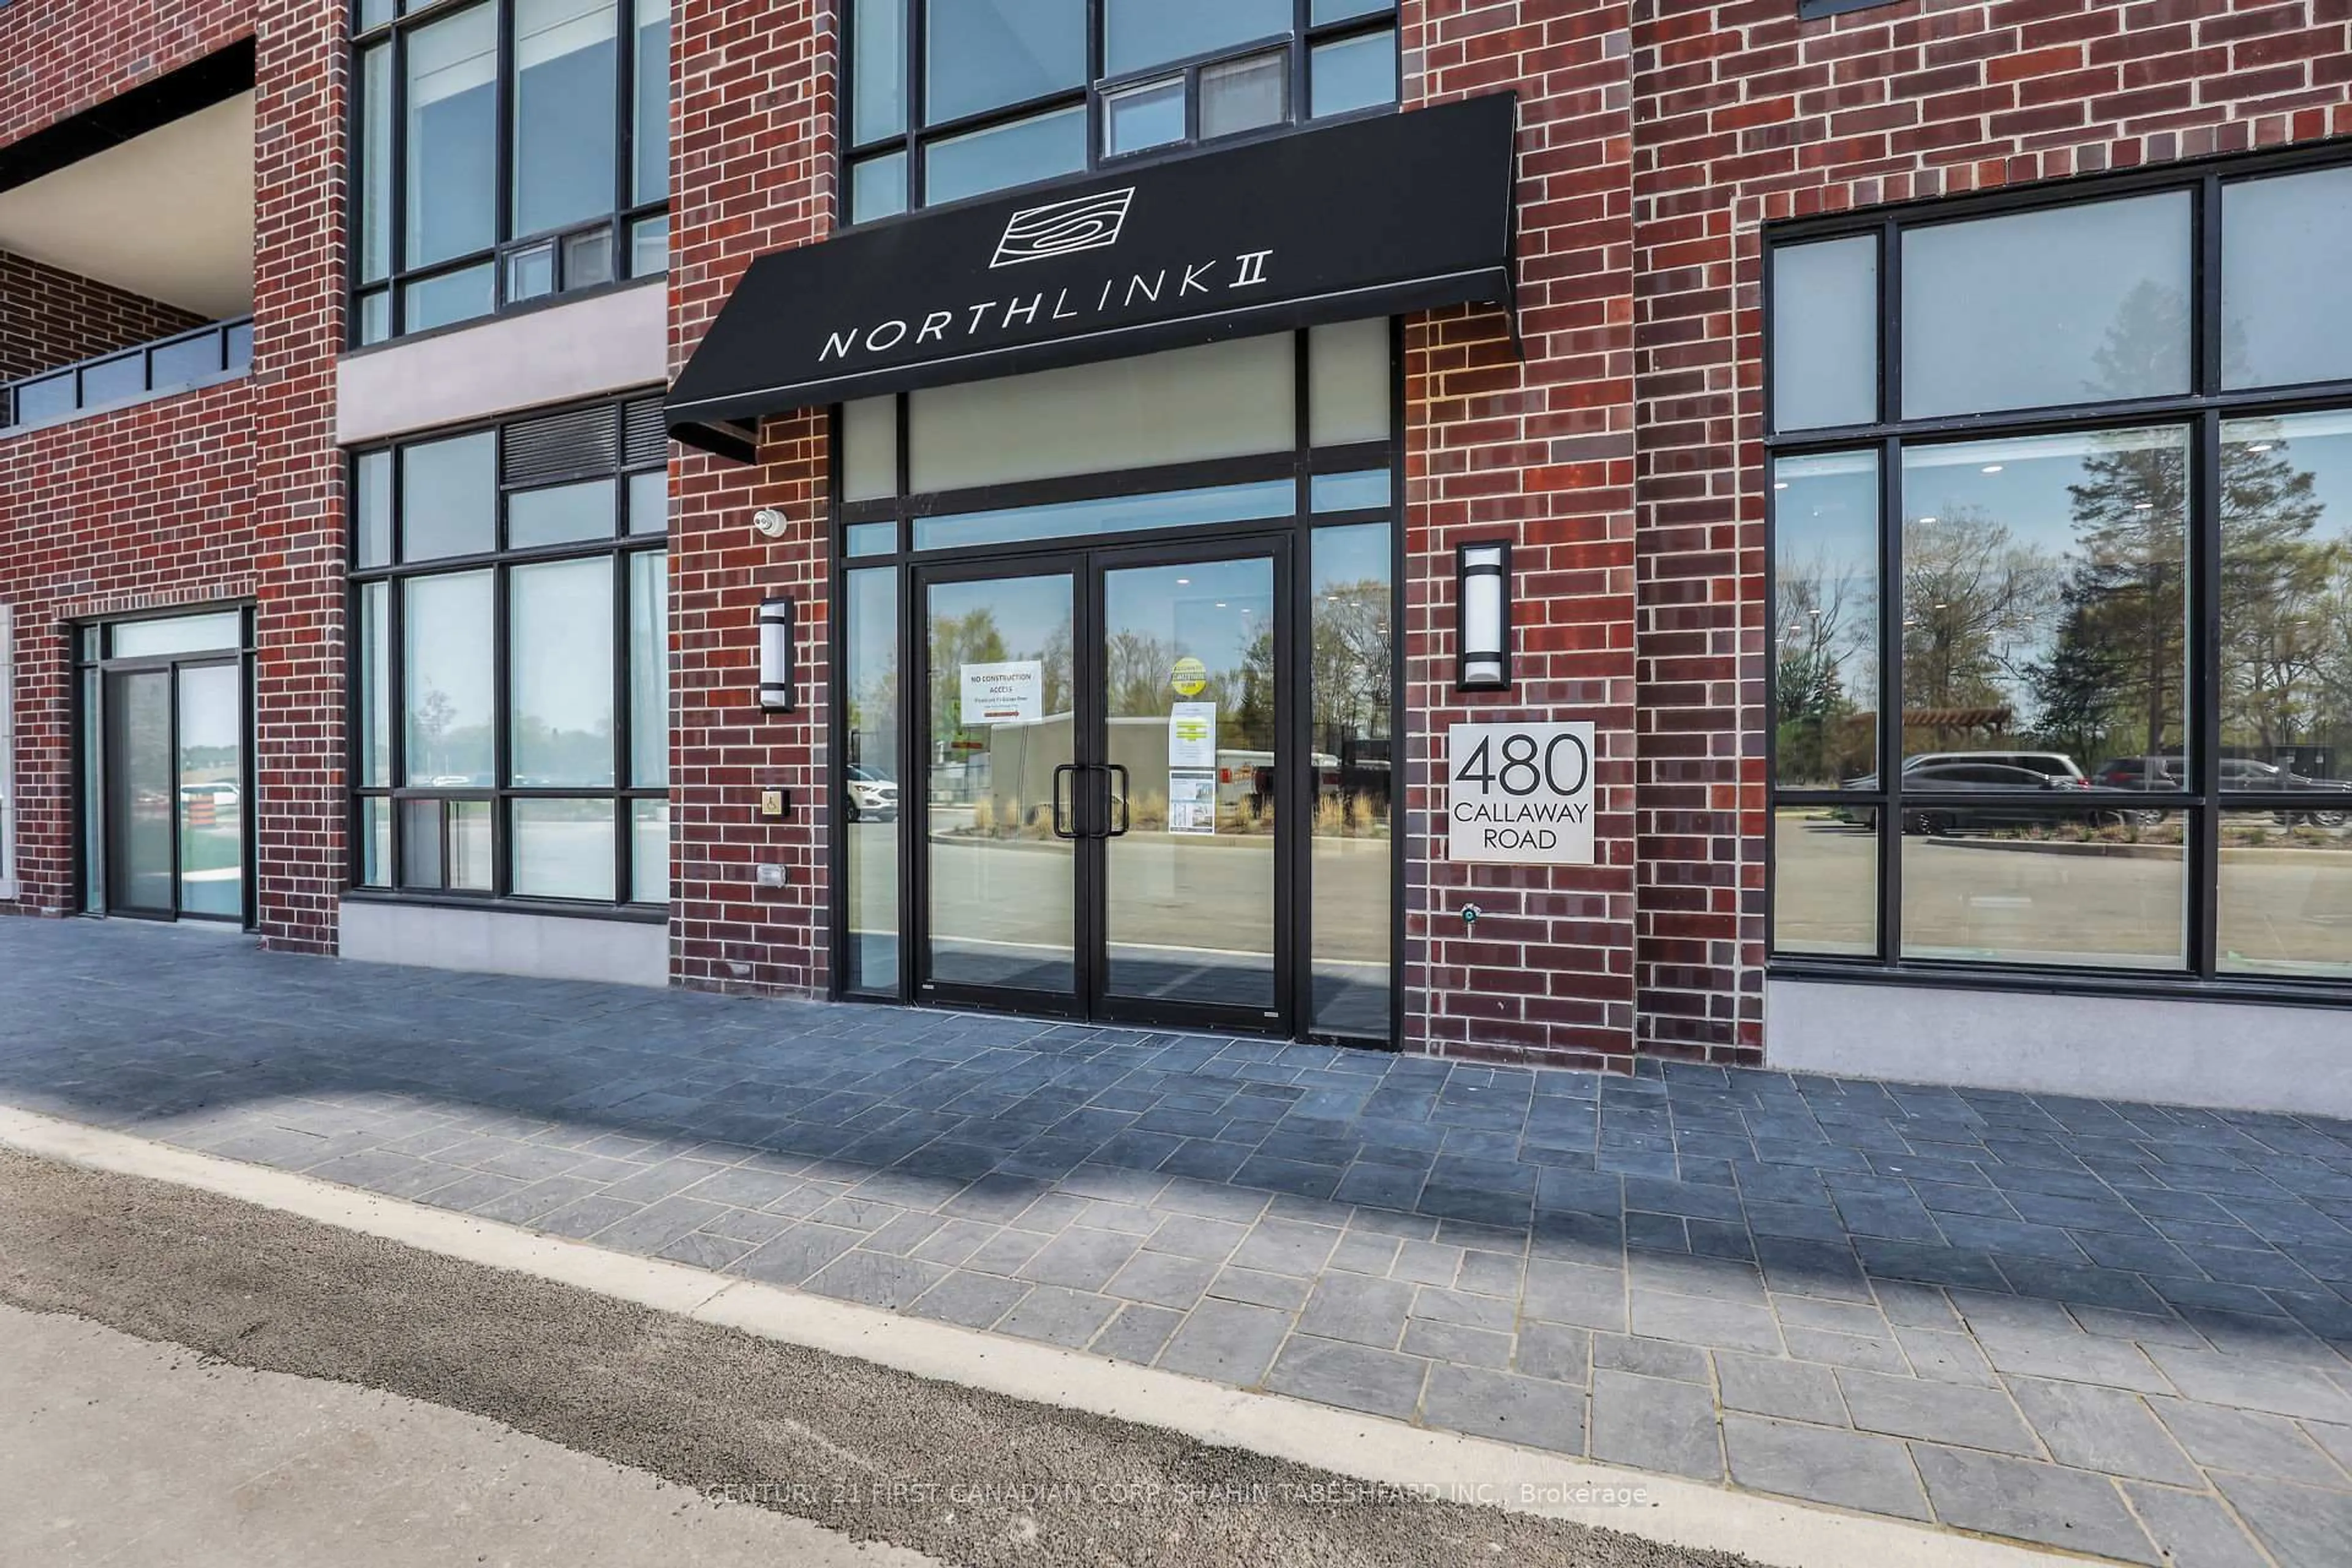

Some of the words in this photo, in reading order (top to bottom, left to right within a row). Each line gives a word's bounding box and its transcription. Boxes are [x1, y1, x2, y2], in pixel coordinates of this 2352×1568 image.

[818, 260, 1216, 361] NORTHLINK
[1229, 249, 1273, 288] II
[1455, 733, 1588, 796] 480
[1454, 802, 1588, 823] CALLAWAY
[1484, 829, 1556, 849] ROAD
